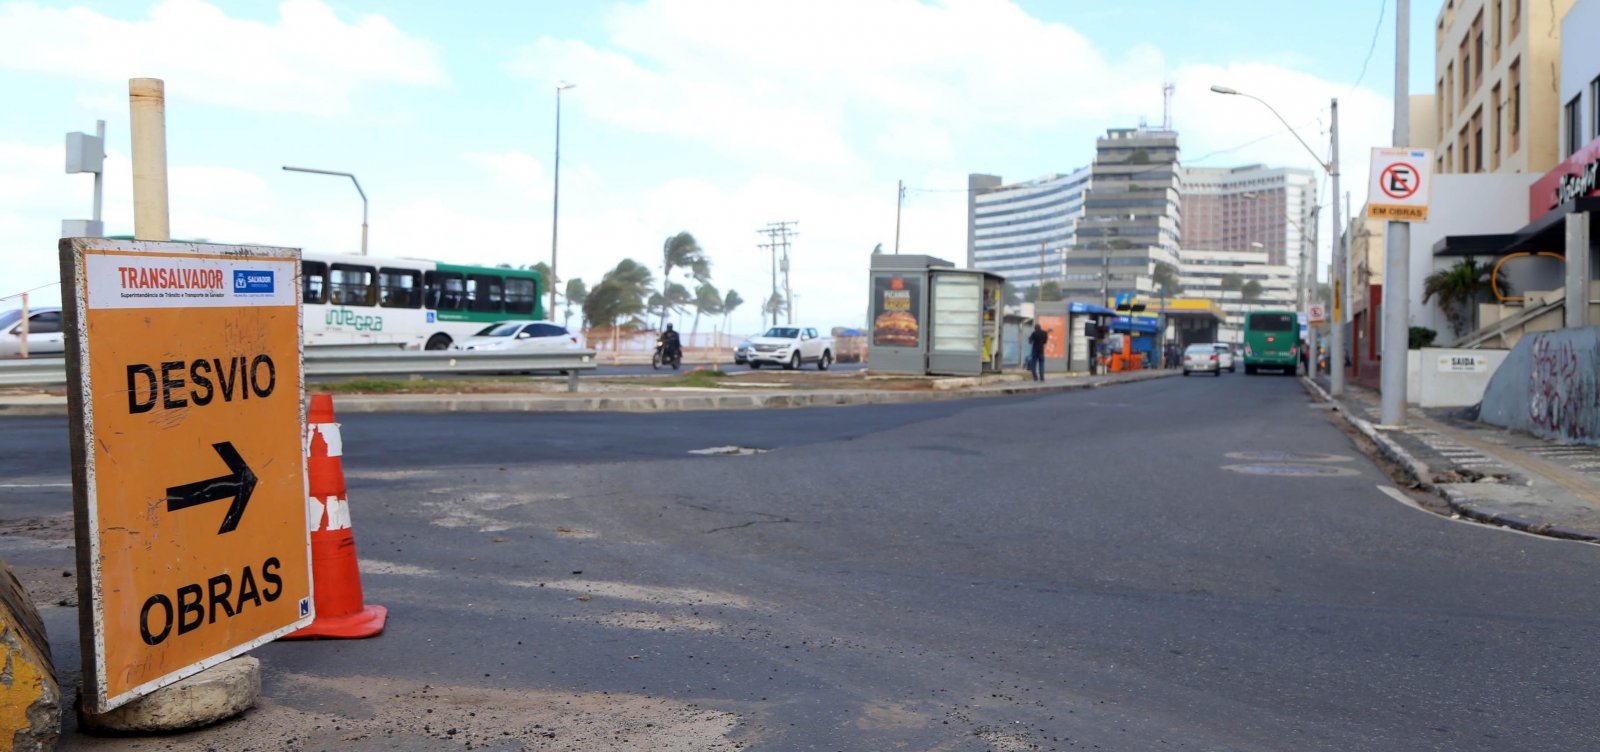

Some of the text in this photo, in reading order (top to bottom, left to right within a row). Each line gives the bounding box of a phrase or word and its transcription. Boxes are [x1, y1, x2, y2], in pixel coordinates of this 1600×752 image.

[1372, 207, 1423, 217] EM OBRAS
[118, 267, 224, 289] TRANSALVADOR
[247, 275, 271, 283] SALVADOR
[126, 354, 276, 414] DESVIO
[140, 556, 283, 646] OBRAS
